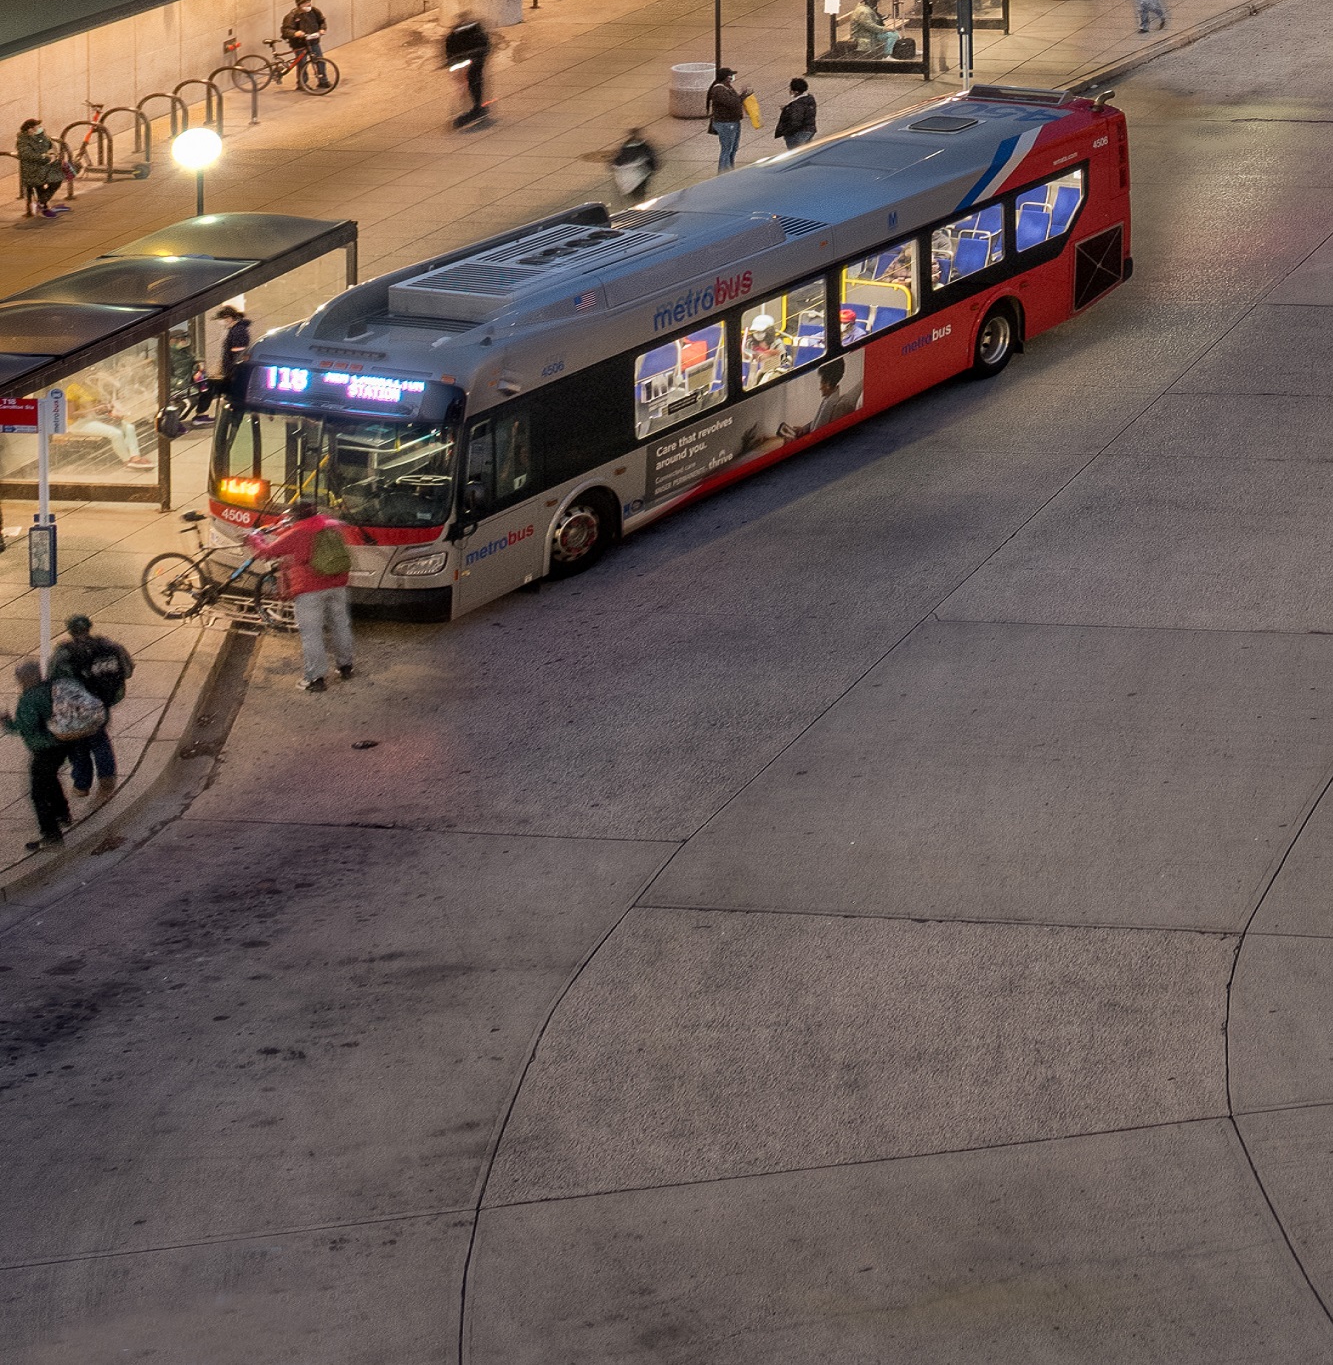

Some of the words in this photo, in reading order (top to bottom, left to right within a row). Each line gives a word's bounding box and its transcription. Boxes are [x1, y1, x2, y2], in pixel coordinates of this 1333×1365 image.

[1093, 136, 1109, 149] 4506
[653, 270, 754, 332] metrobus
[902, 324, 952, 355] metrobus
[541, 360, 566, 378] 4506
[656, 441, 678, 457] Care
[678, 431, 697, 447] that
[697, 416, 734, 439] revolves
[655, 448, 688, 471] around
[688, 441, 708, 458] you.
[708, 453, 734, 470] thrive
[221, 507, 251, 524] 4506
[465, 524, 535, 566] metrobus
